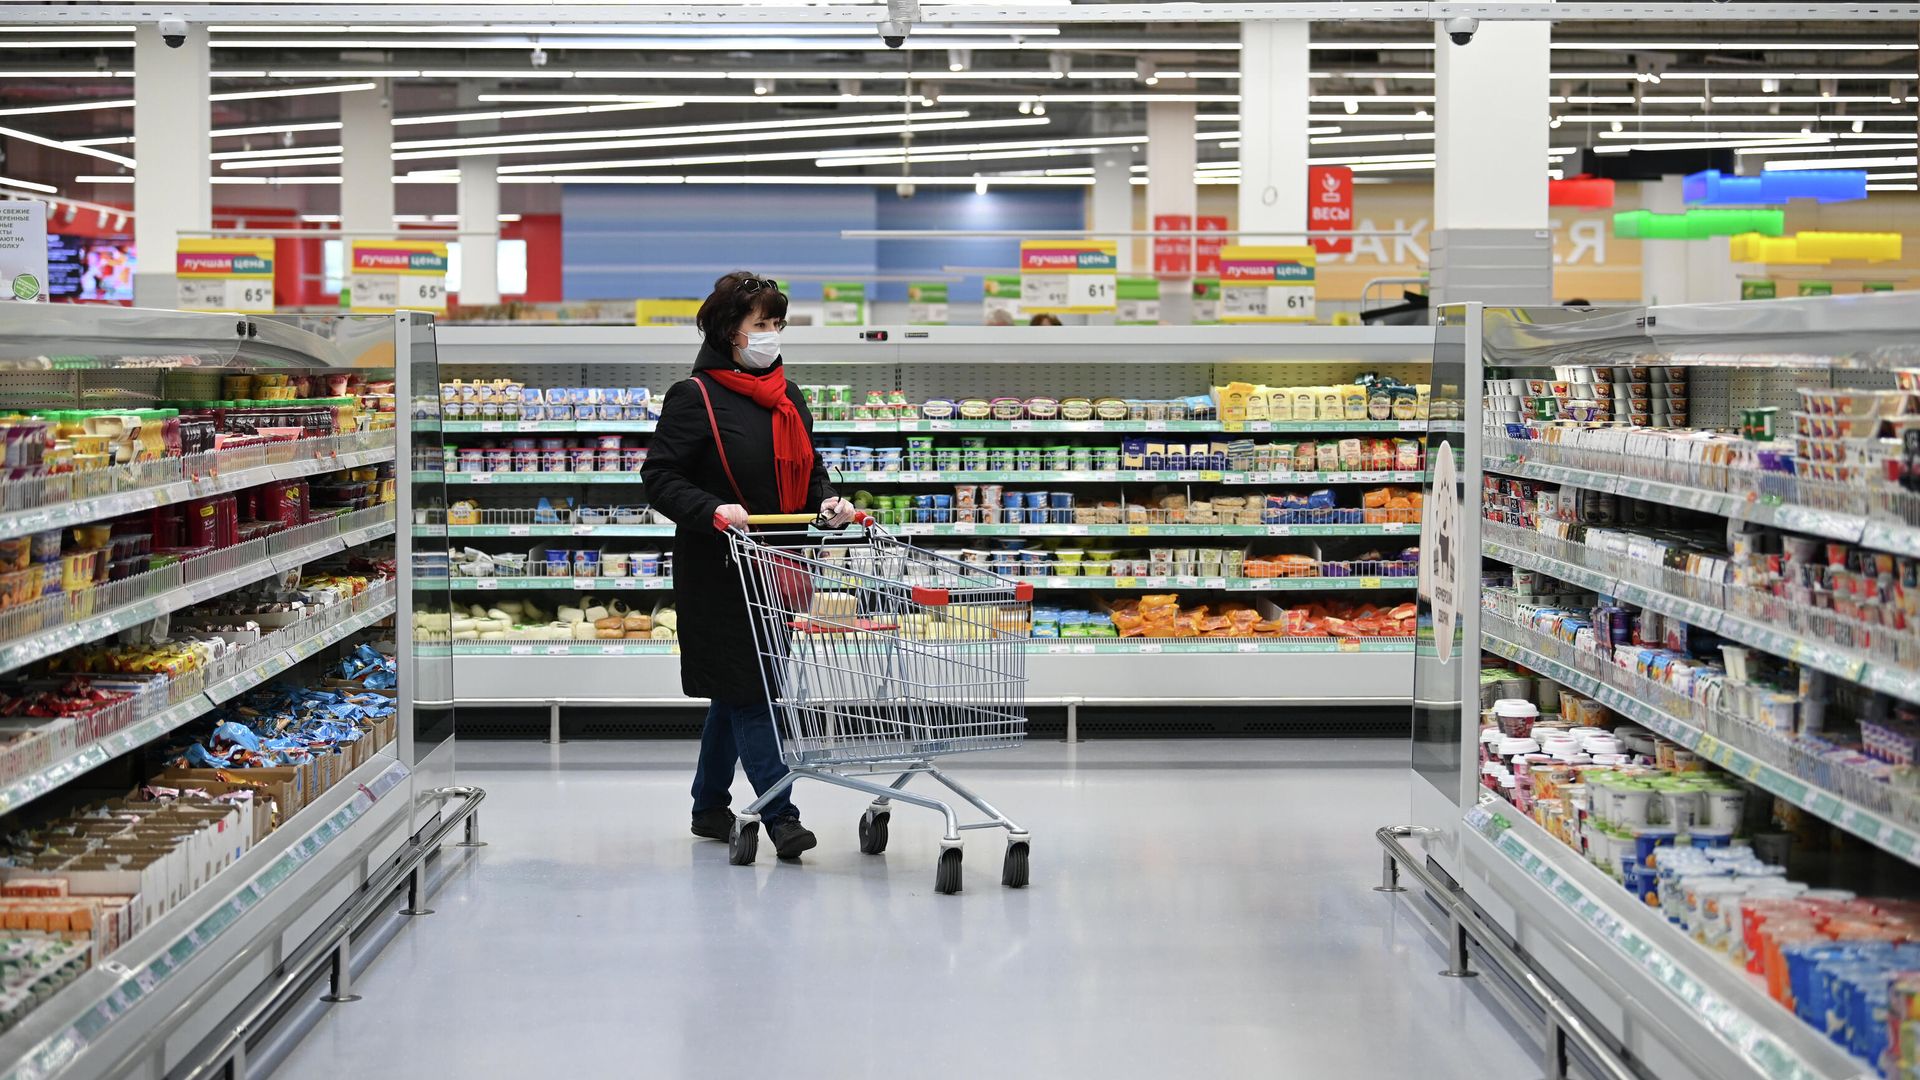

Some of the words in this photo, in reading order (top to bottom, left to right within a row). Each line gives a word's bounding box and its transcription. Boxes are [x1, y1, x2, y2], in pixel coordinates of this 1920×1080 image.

[1312, 206, 1350, 221] ВЕСЫ
[183, 259, 232, 271] лучшая
[234, 259, 265, 270] цена
[361, 254, 409, 266] лучшая
[411, 255, 442, 266] цена
[1029, 255, 1077, 266] лучшая
[1078, 255, 1110, 265] цена
[1227, 266, 1275, 278] лучшая
[1276, 266, 1308, 276] цена
